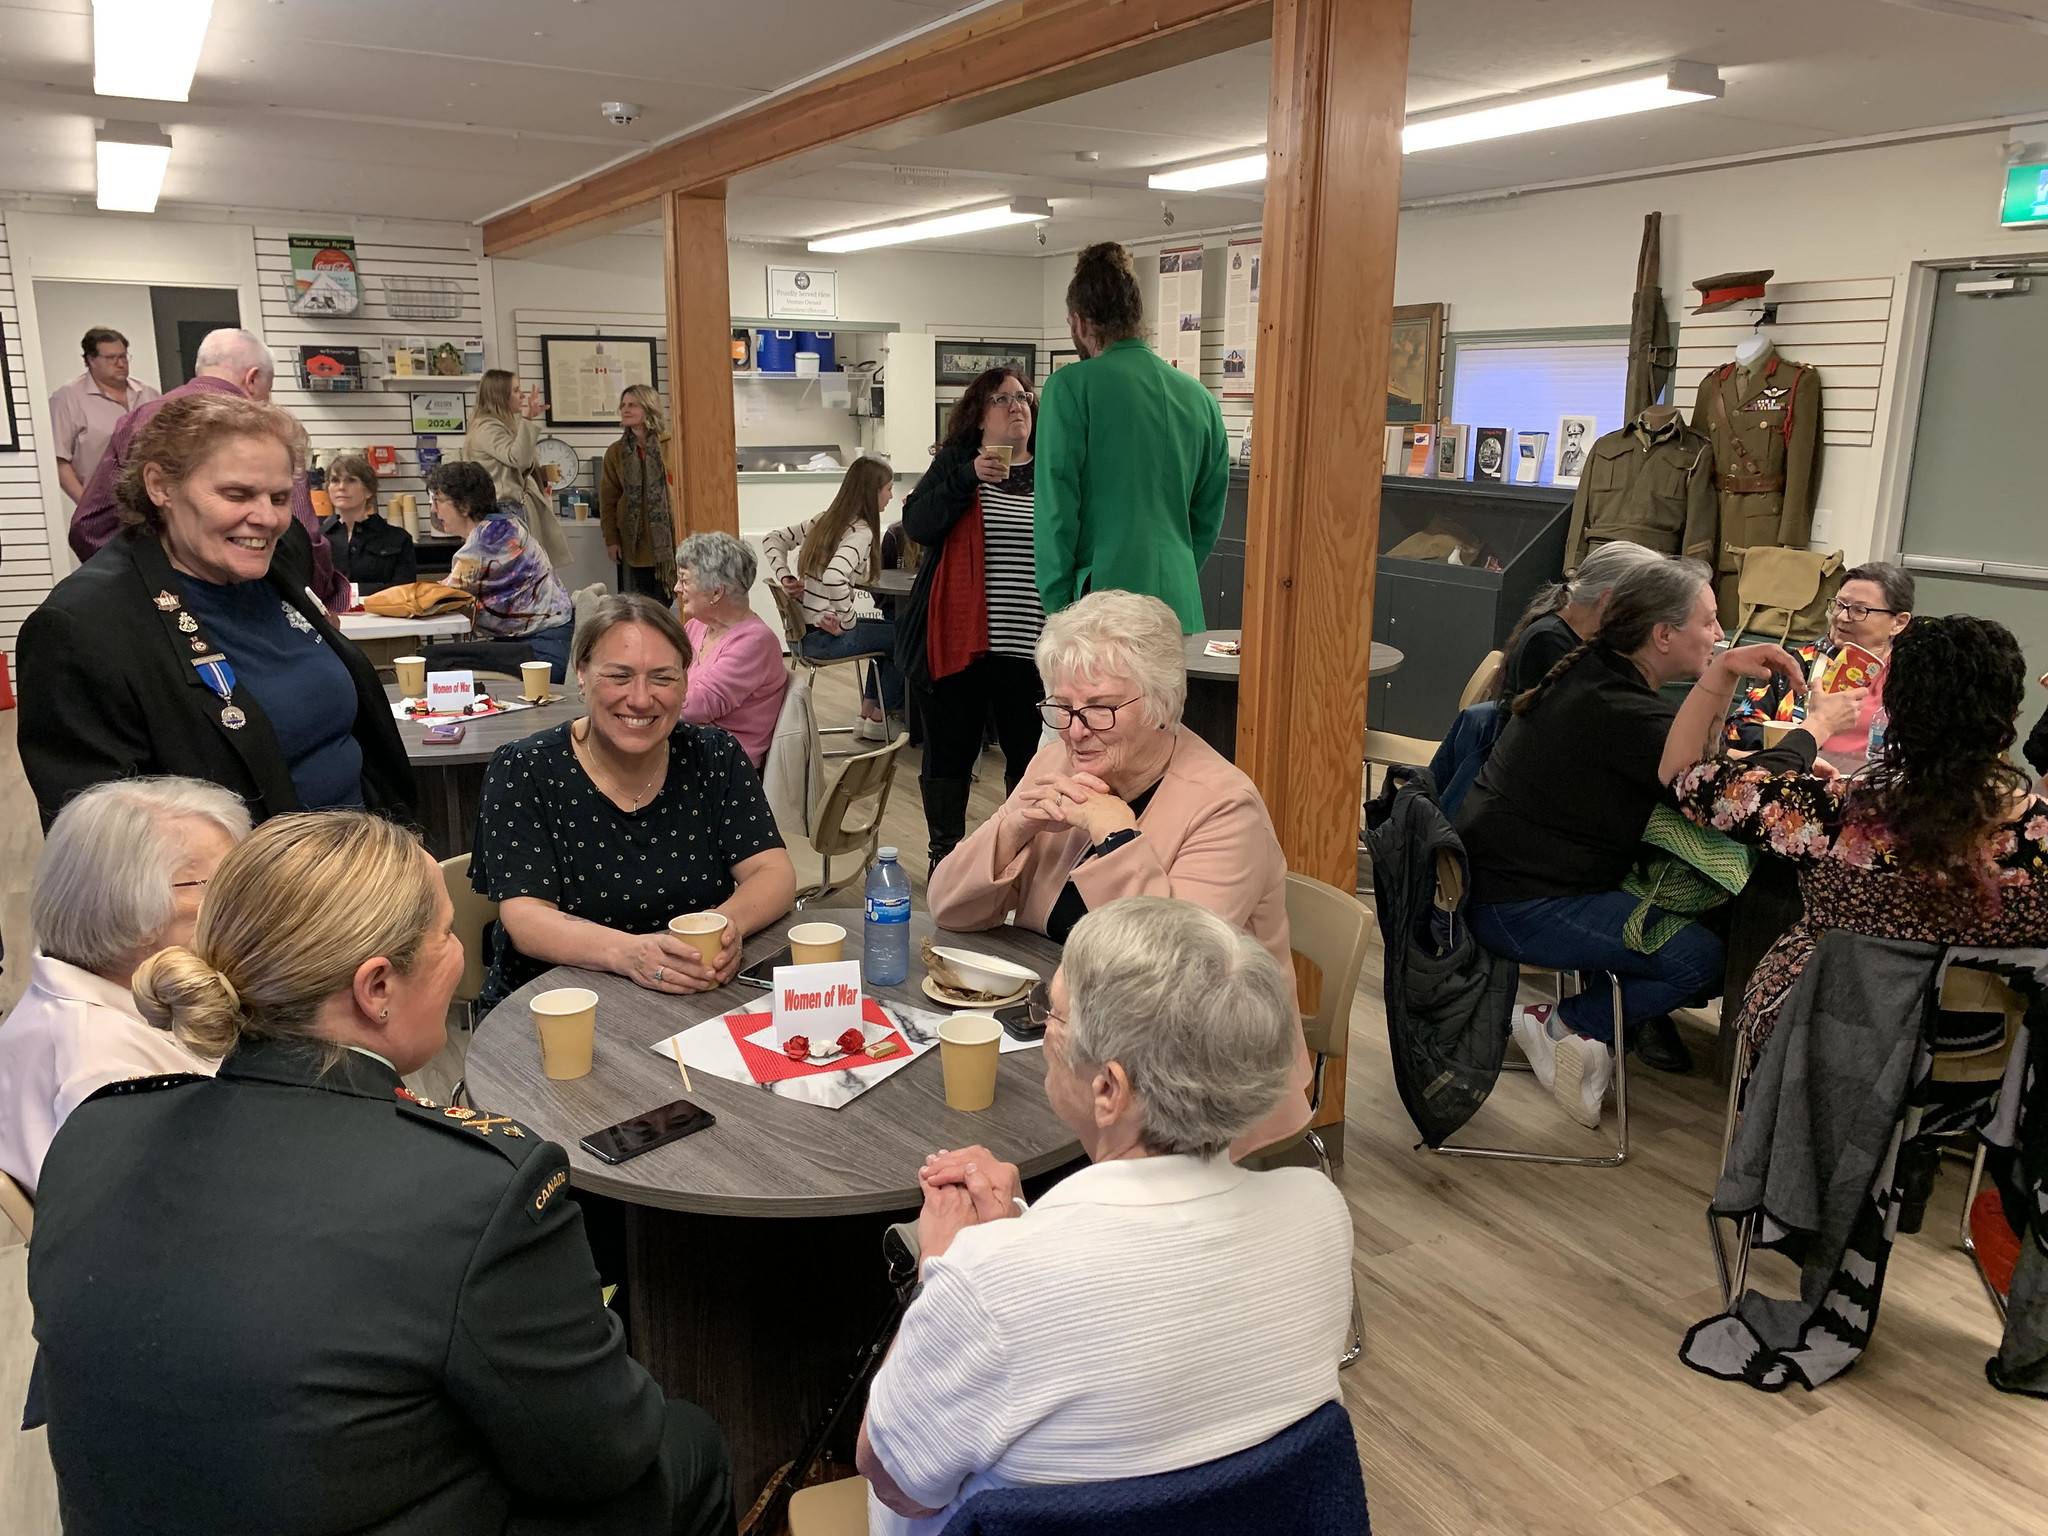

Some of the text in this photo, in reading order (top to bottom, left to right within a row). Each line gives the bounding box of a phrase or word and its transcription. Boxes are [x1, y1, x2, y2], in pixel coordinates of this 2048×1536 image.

[776, 289, 798, 297] Proudly
[428, 420, 451, 428] 2024
[432, 682, 471, 694] Women of War
[784, 984, 858, 1012] Women of War
